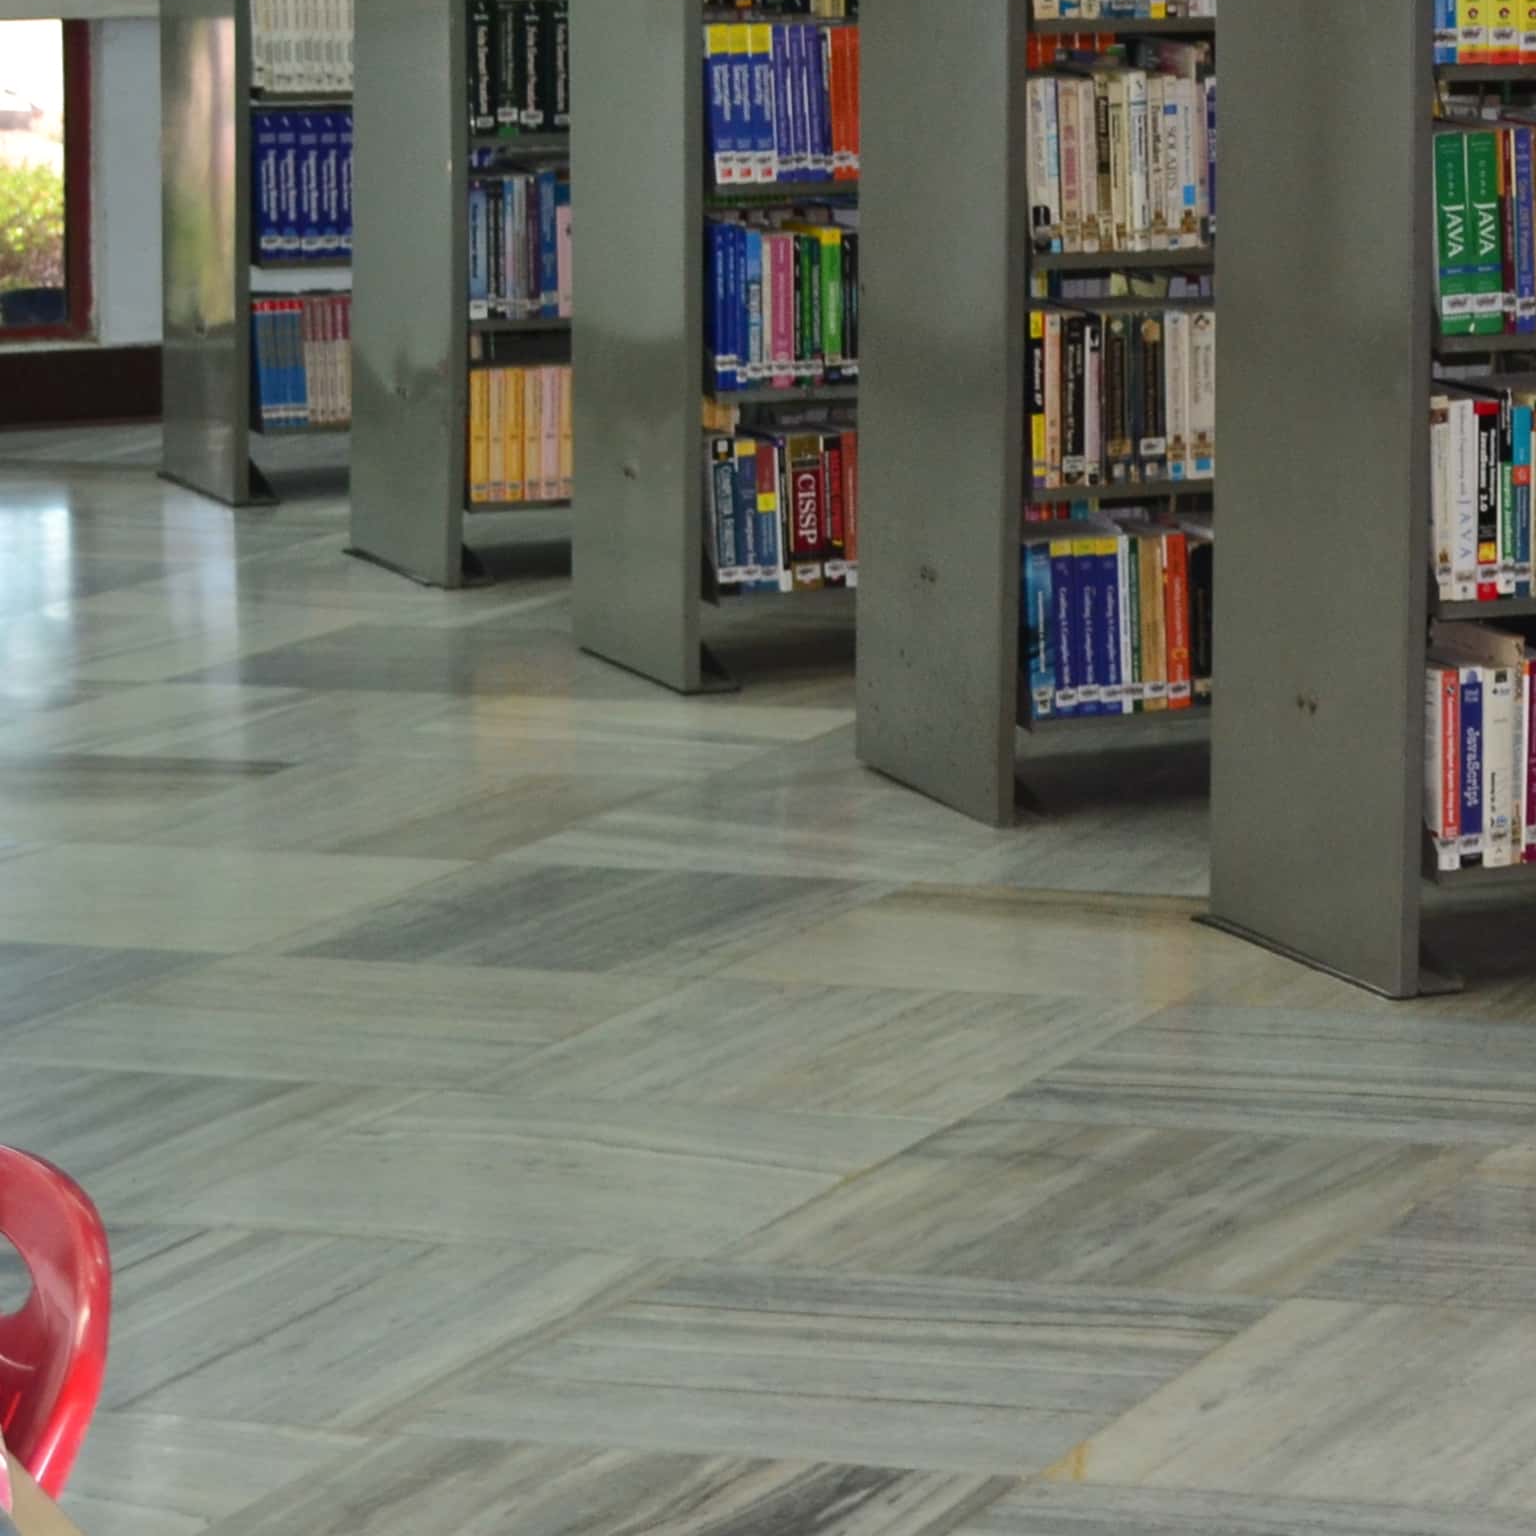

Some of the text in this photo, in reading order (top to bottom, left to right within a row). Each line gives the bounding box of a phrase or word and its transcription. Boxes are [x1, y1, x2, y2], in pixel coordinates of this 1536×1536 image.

[1473, 202, 1496, 256] JAVA
[797, 474, 817, 545] CISSP
[1464, 727, 1480, 807] JavaScript
